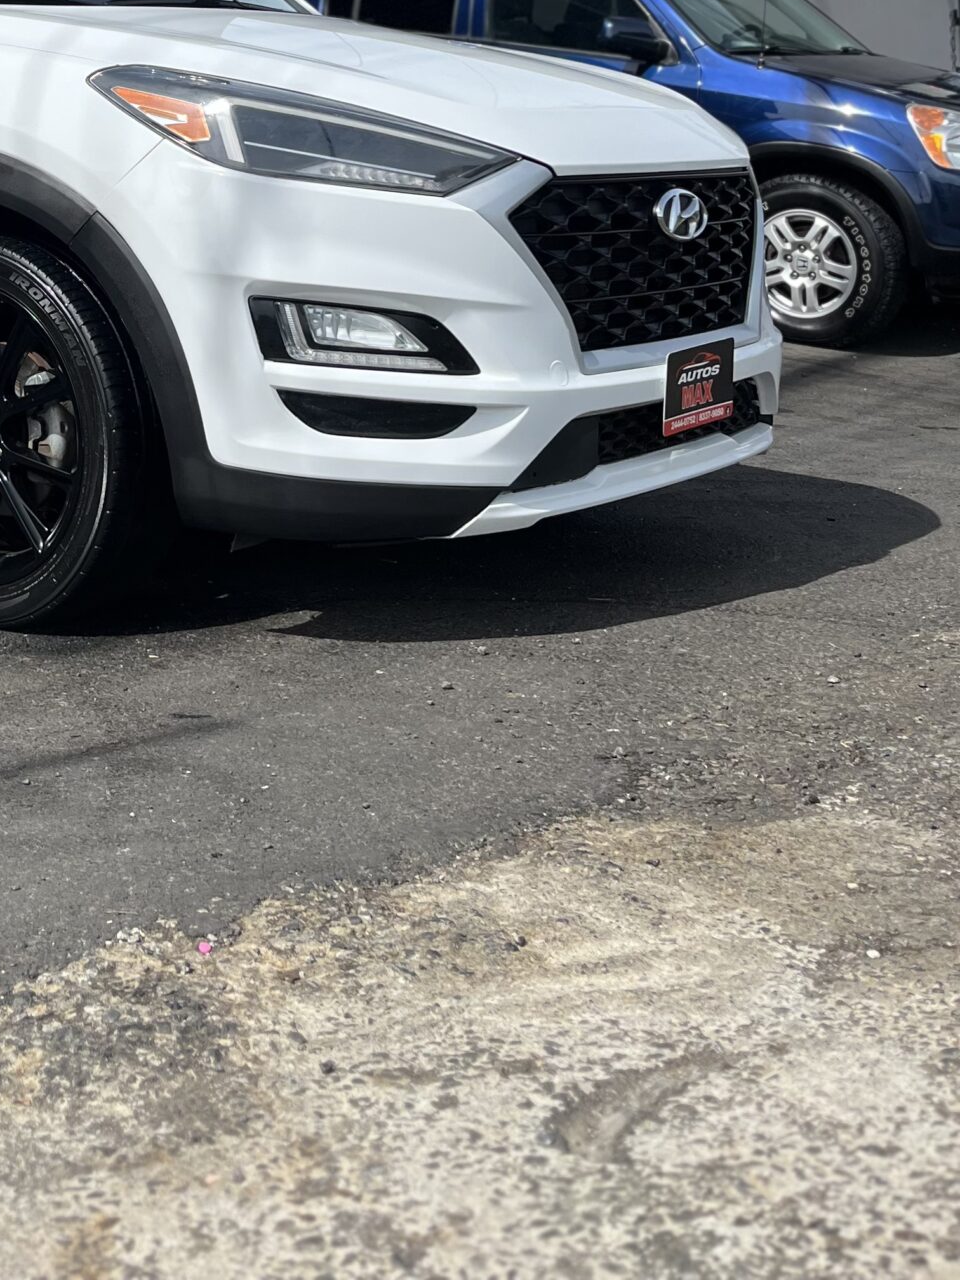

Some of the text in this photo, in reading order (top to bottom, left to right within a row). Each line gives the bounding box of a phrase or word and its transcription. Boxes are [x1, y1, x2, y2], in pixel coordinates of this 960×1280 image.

[9, 272, 86, 366] IRONMAN
[677, 364, 720, 385] AUTOS
[681, 379, 713, 410] MAX
